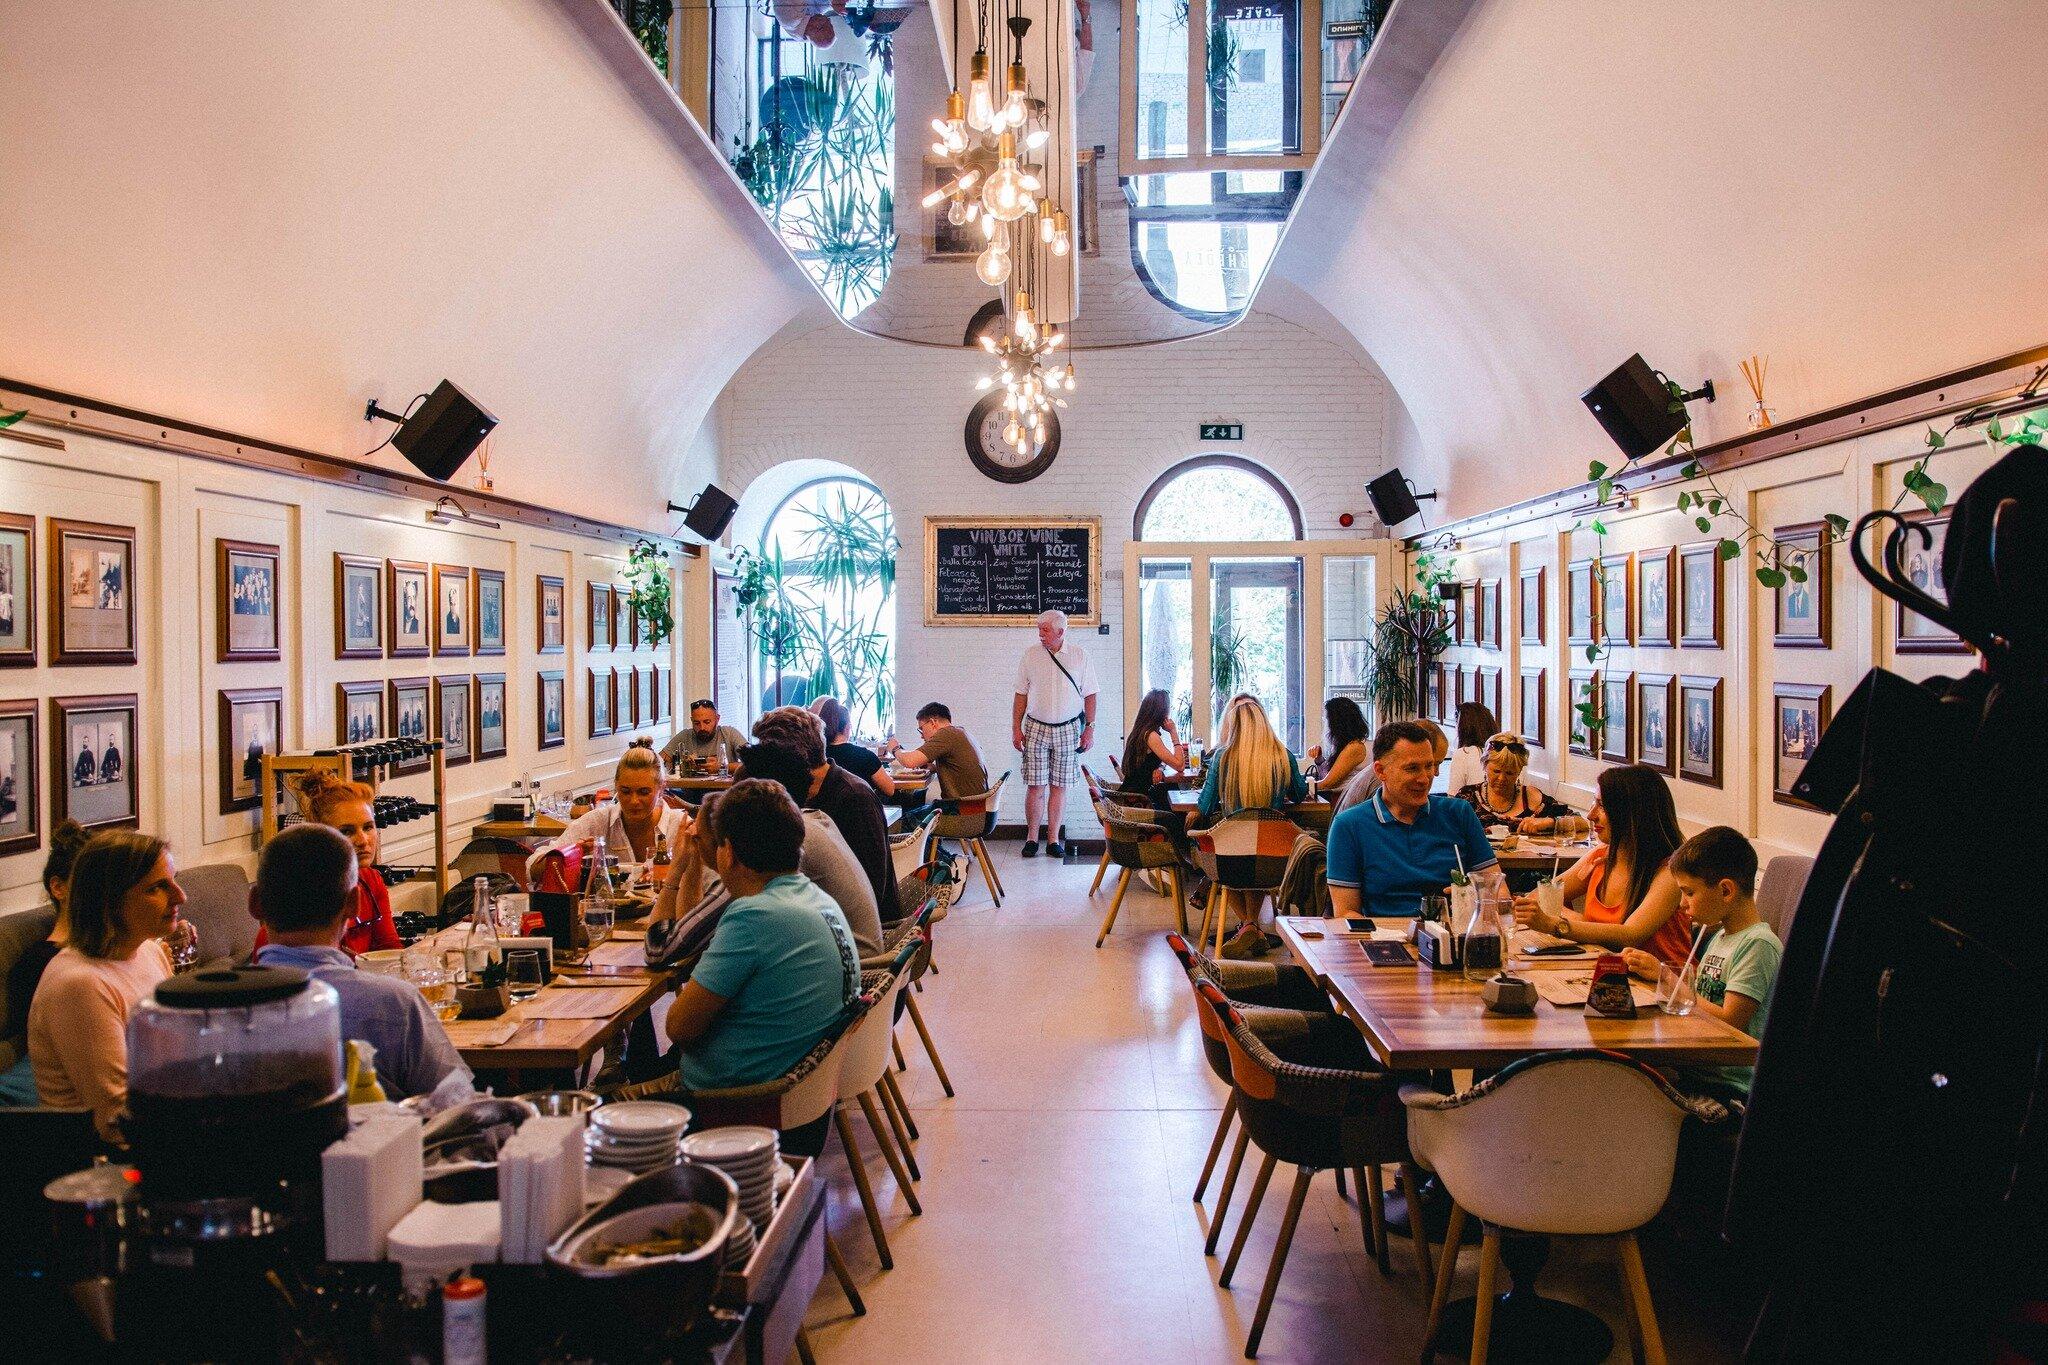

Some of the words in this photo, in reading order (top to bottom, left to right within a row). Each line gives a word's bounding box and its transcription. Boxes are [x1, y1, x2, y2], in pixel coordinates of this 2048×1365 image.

[989, 421, 997, 429] 10
[952, 545, 976, 557] RED
[993, 543, 1028, 557] WHITE
[1044, 544, 1078, 558] ROZE
